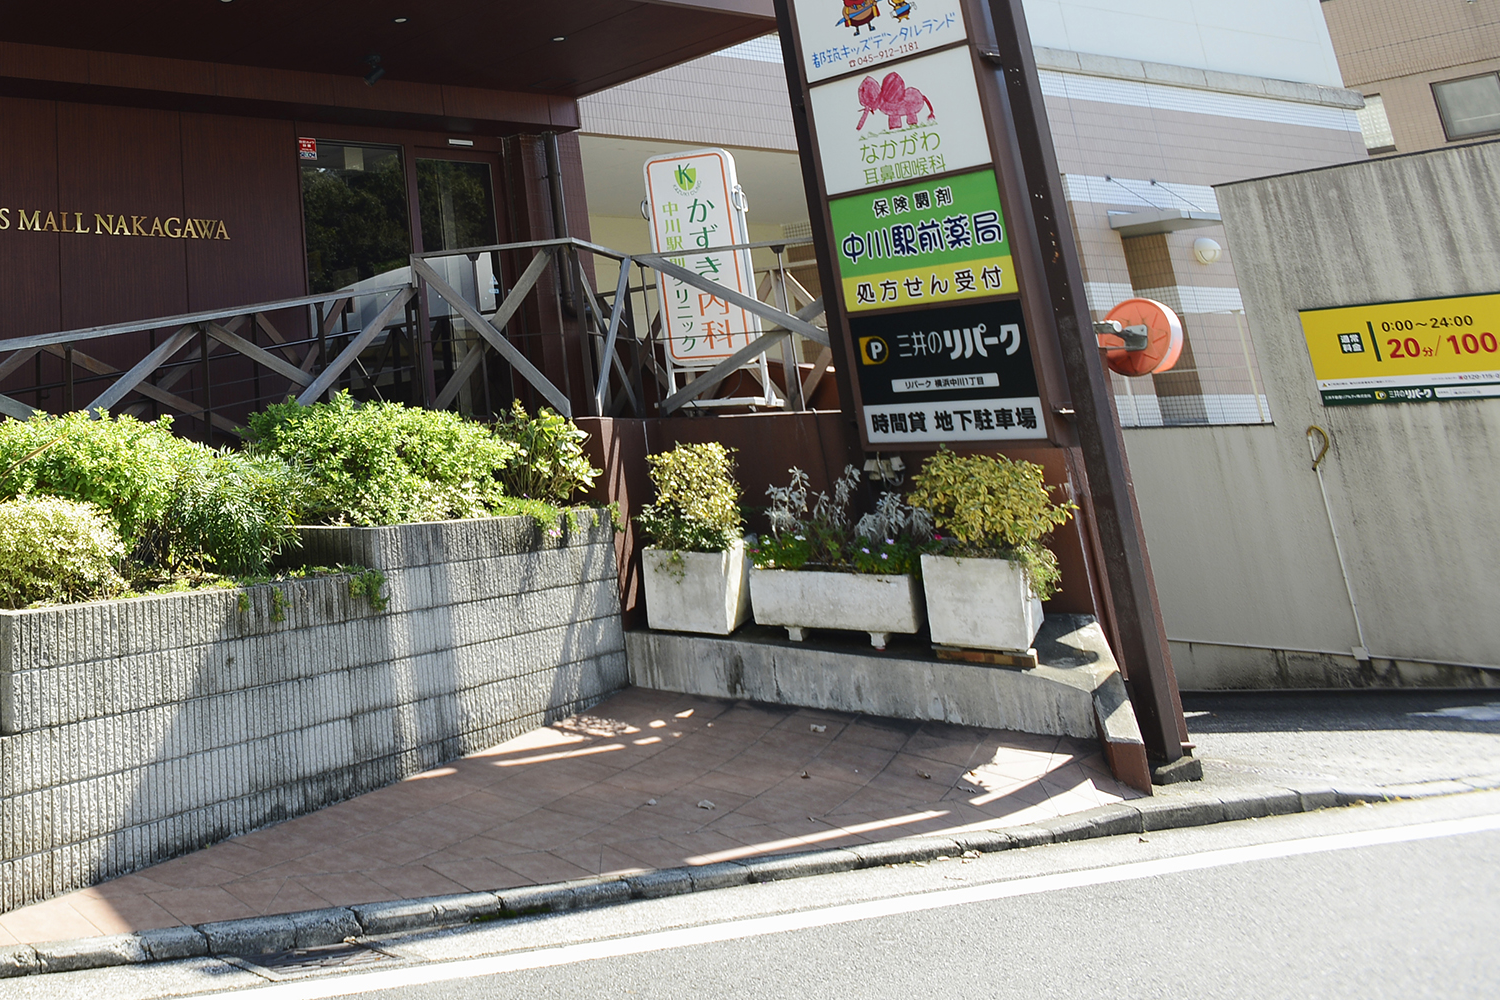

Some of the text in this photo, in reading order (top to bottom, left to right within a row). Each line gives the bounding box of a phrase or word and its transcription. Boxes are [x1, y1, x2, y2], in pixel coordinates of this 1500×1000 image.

[811, 12, 956, 68] 都筑キッズデンタルランド
[857, 41, 920, 66] 045-912-1181
[859, 130, 942, 164] なかがわ
[863, 153, 947, 186] 耳鼻咽喉科
[872, 186, 953, 218] 保険調剤
[17, 209, 91, 235] MALL
[94, 213, 231, 241] NAKAGAWA
[841, 210, 1003, 265] 中川駅前薬局
[855, 265, 1003, 304] 処方せん受付
[896, 323, 1021, 360] 三井のリパーク
[904, 379, 932, 389] リパーク
[871, 407, 1038, 434] 時間貸 地下駐車場
